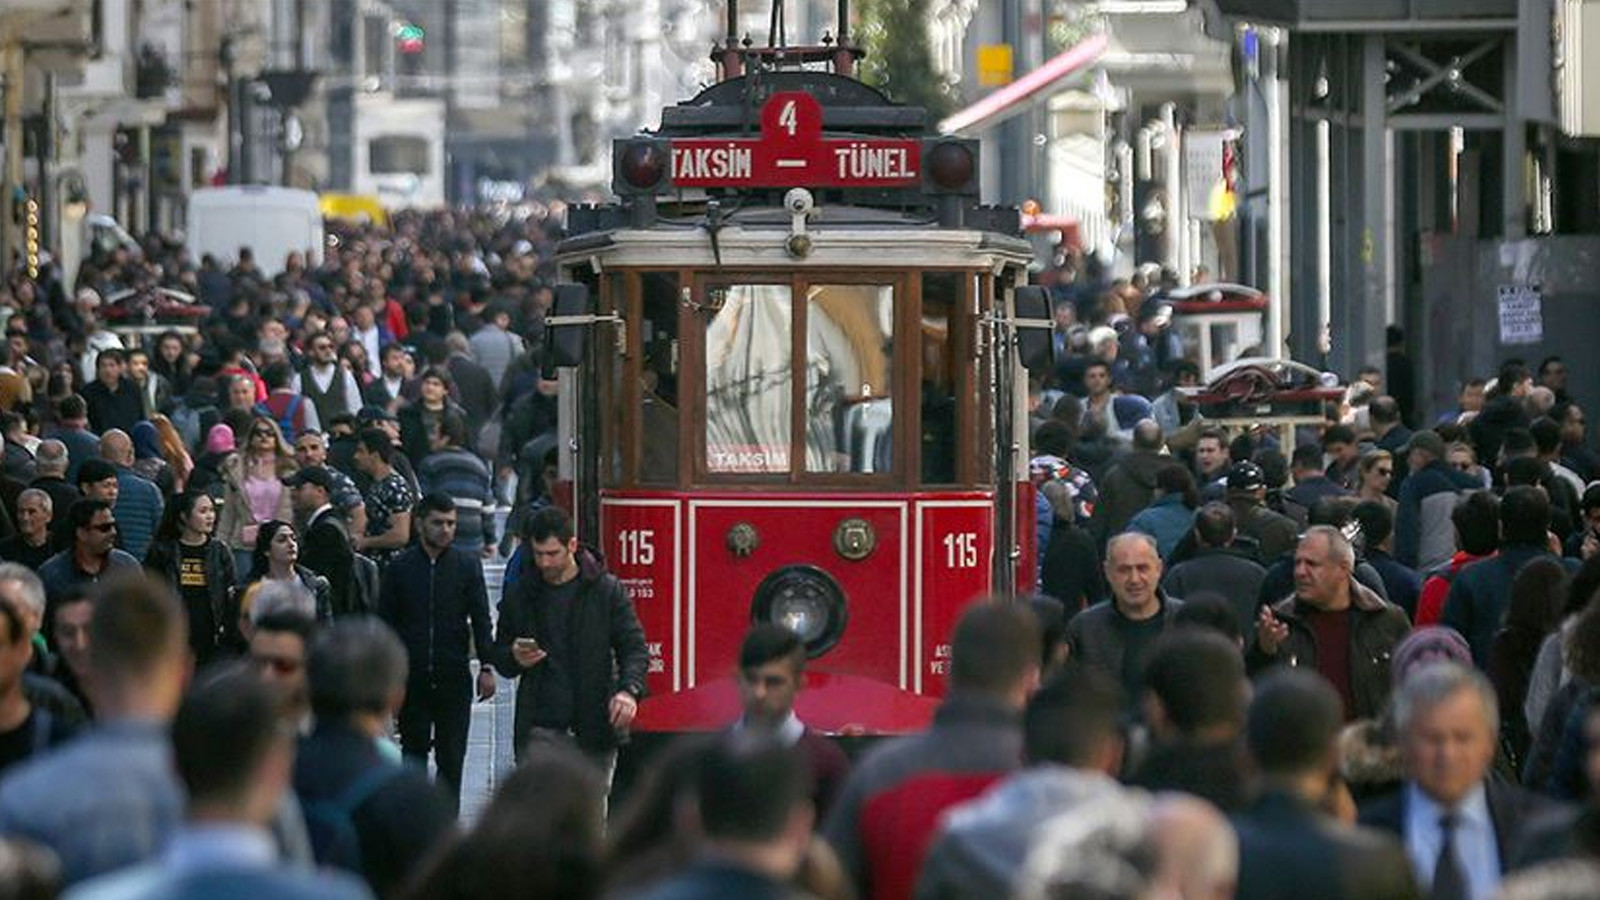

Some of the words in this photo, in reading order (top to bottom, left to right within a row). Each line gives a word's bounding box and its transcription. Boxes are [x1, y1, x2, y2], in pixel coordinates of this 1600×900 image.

[779, 100, 797, 136] 4
[671, 143, 751, 178] TAKSİM
[835, 143, 915, 178] TÜNEL
[619, 530, 654, 564] 115
[944, 533, 977, 567] 115
